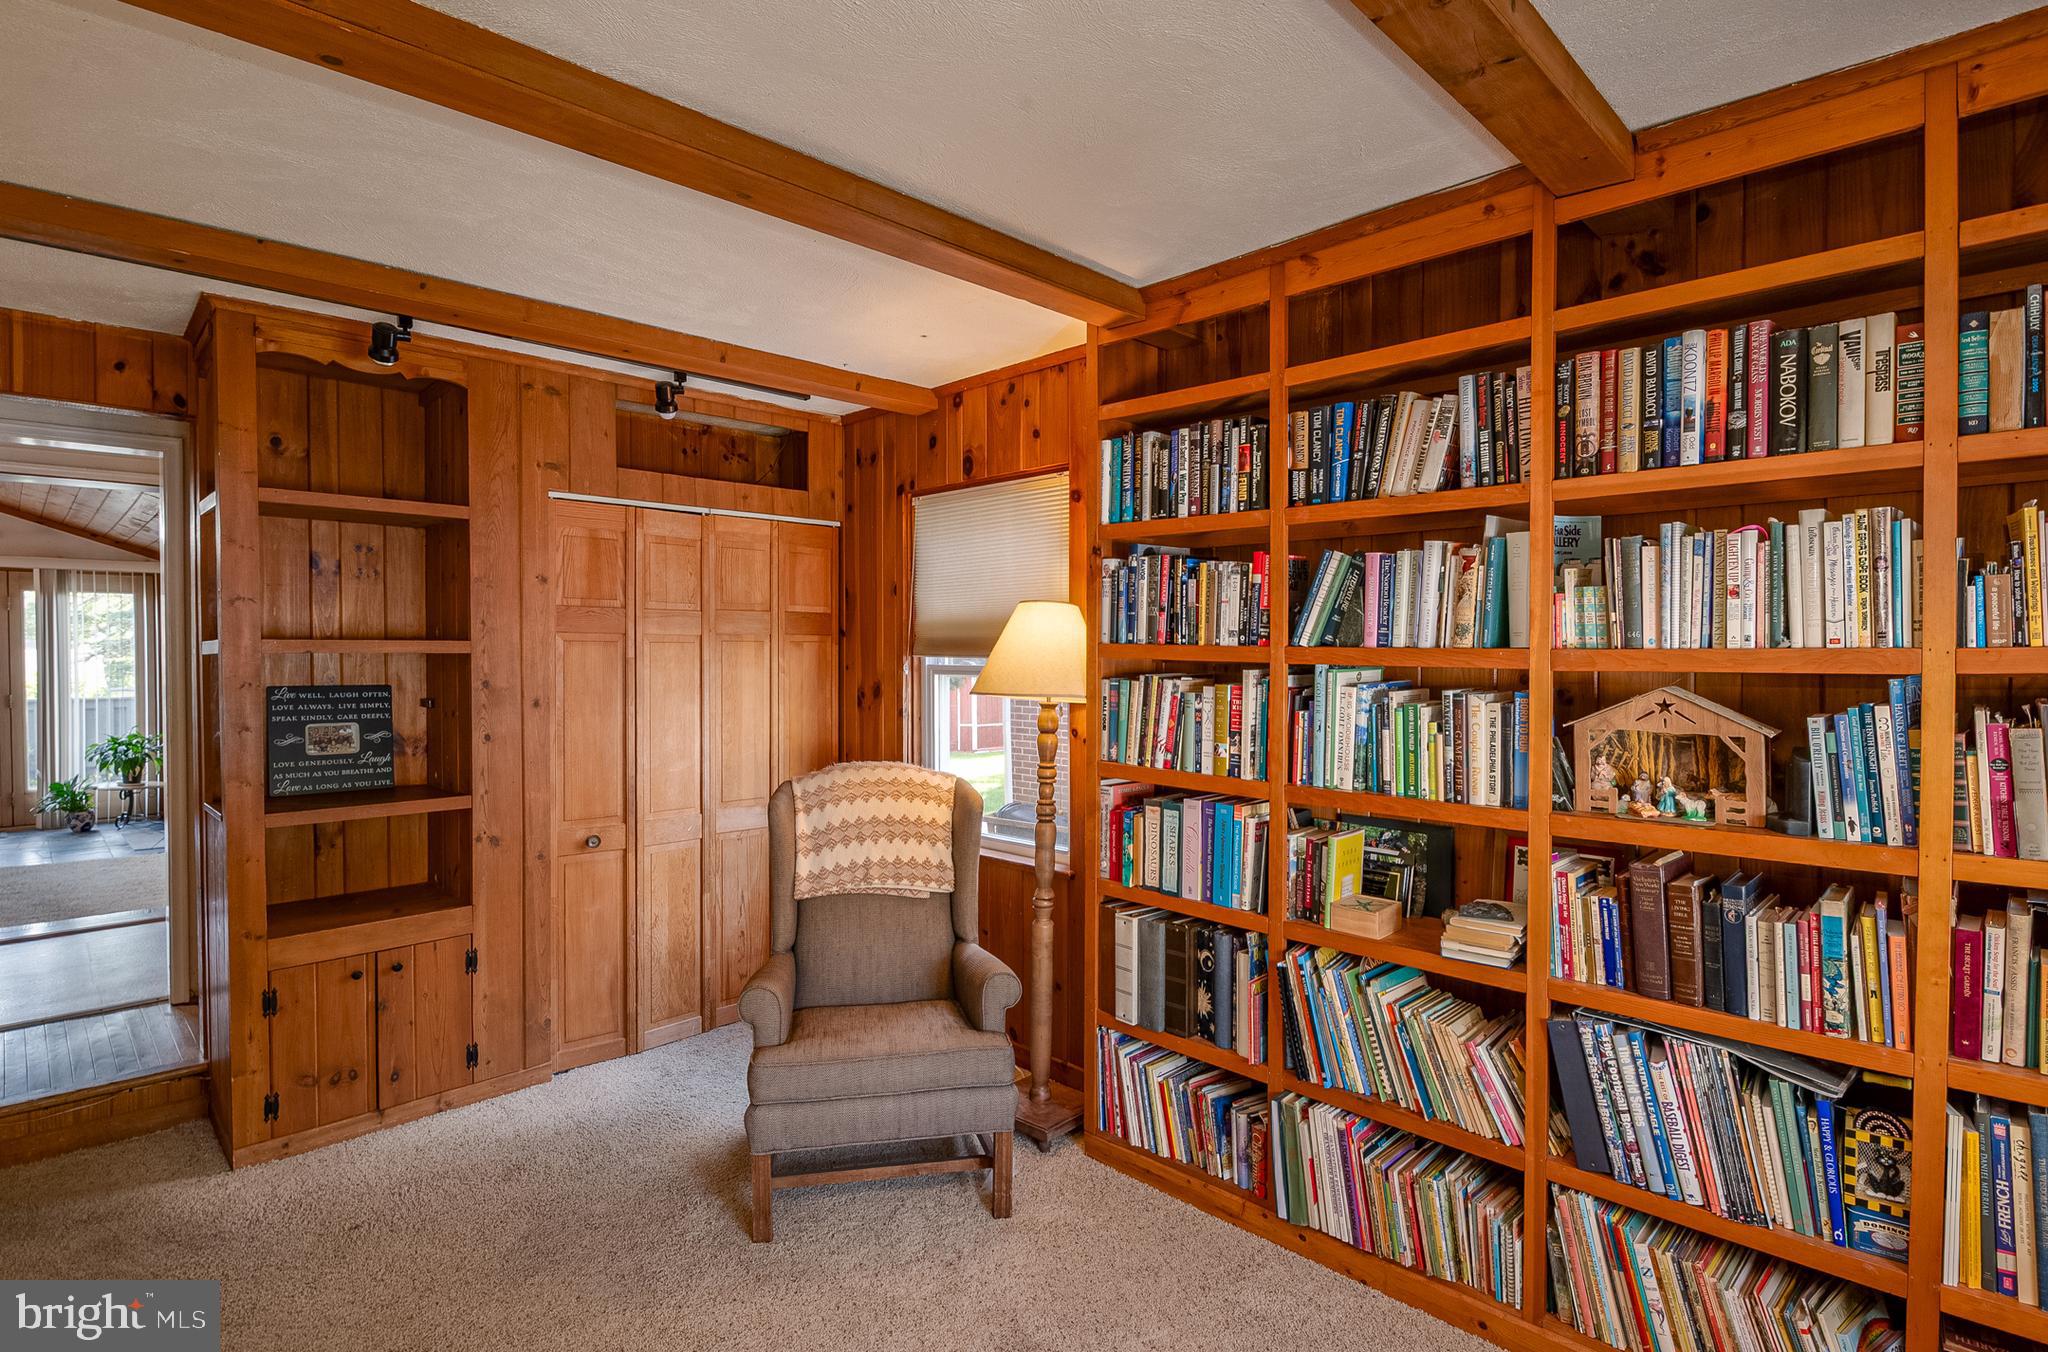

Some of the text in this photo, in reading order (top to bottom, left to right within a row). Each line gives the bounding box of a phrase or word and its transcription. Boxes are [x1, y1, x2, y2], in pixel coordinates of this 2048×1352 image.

[2030, 294, 2040, 330] CHIHULY
[1780, 339, 1796, 348] ADA
[1578, 356, 1592, 400] DAN BROWN
[1622, 352, 1634, 420] DAVID BALDACCI
[1646, 350, 1656, 418] DAVID BALDACCI
[1684, 347, 1698, 394] KOONTZ
[1779, 354, 1796, 428] NABOKOV
[1866, 346, 1891, 393] Trespass
[1313, 410, 1321, 462] TOM CLANCY
[1336, 408, 1345, 426] TOM
[1754, 388, 1762, 441] MORRIS WEST
[1334, 428, 1343, 460] CLANCY
[1371, 406, 1390, 471] WASHINGTON,
[1239, 478, 1247, 500] FUND
[1564, 525, 1581, 536] Side
[1728, 539, 1740, 584] LIGHTEN UP
[1341, 570, 1360, 611] LITERATURE
[1990, 592, 2000, 619] peaceful
[270, 687, 296, 702] Live
[1520, 698, 1528, 752] BORN TO RUN
[1894, 704, 1907, 768] HANDS OF LIGHT
[358, 751, 391, 766] Laugh
[1811, 727, 1822, 769] BILL O'REILLY
[1868, 744, 1876, 772] INSIGHT
[273, 780, 302, 795] Love
[1589, 1056, 1608, 1110] Baseball
[1602, 1036, 1614, 1057] The
[1608, 1060, 1627, 1111] Football
[1619, 1048, 1645, 1126] The World Series
[1631, 1040, 1660, 1136] THE NATIONAL LEAGUE
[1661, 1101, 1683, 1140] BASEBALL
[1672, 1142, 1690, 1172] DIGEST
[1821, 1118, 1831, 1142] HAPPY
[1825, 1154, 1838, 1194] GLORIOUS
[1996, 1180, 2011, 1230] FRENCH
